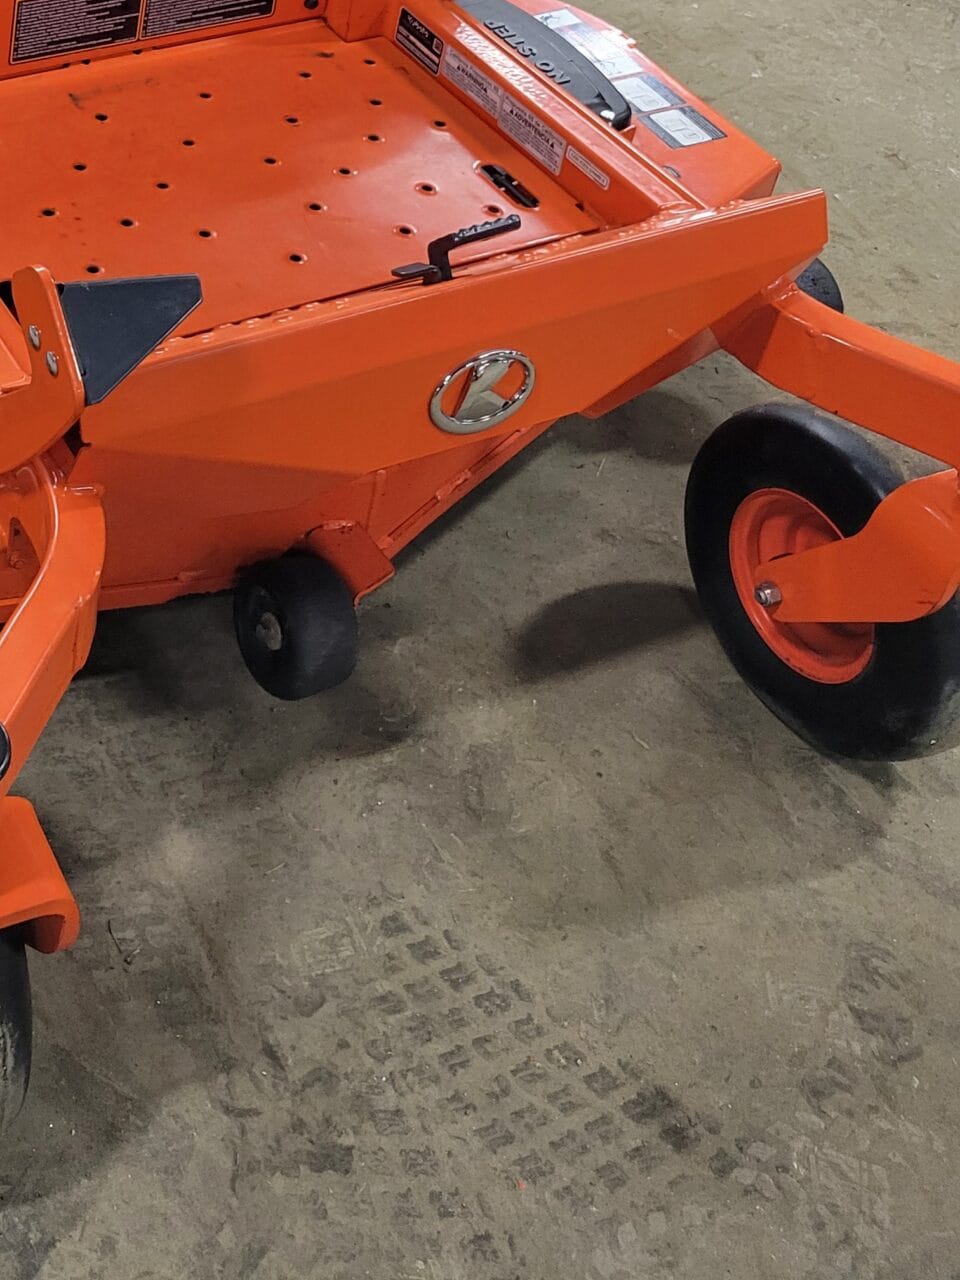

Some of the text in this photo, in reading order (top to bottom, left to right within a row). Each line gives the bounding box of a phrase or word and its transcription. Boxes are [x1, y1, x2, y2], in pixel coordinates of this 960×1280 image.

[483, 19, 538, 59] STEP
[460, 65, 484, 90] WARNING
[534, 58, 572, 86] NO
[514, 110, 550, 145] ADVERTENCIA
